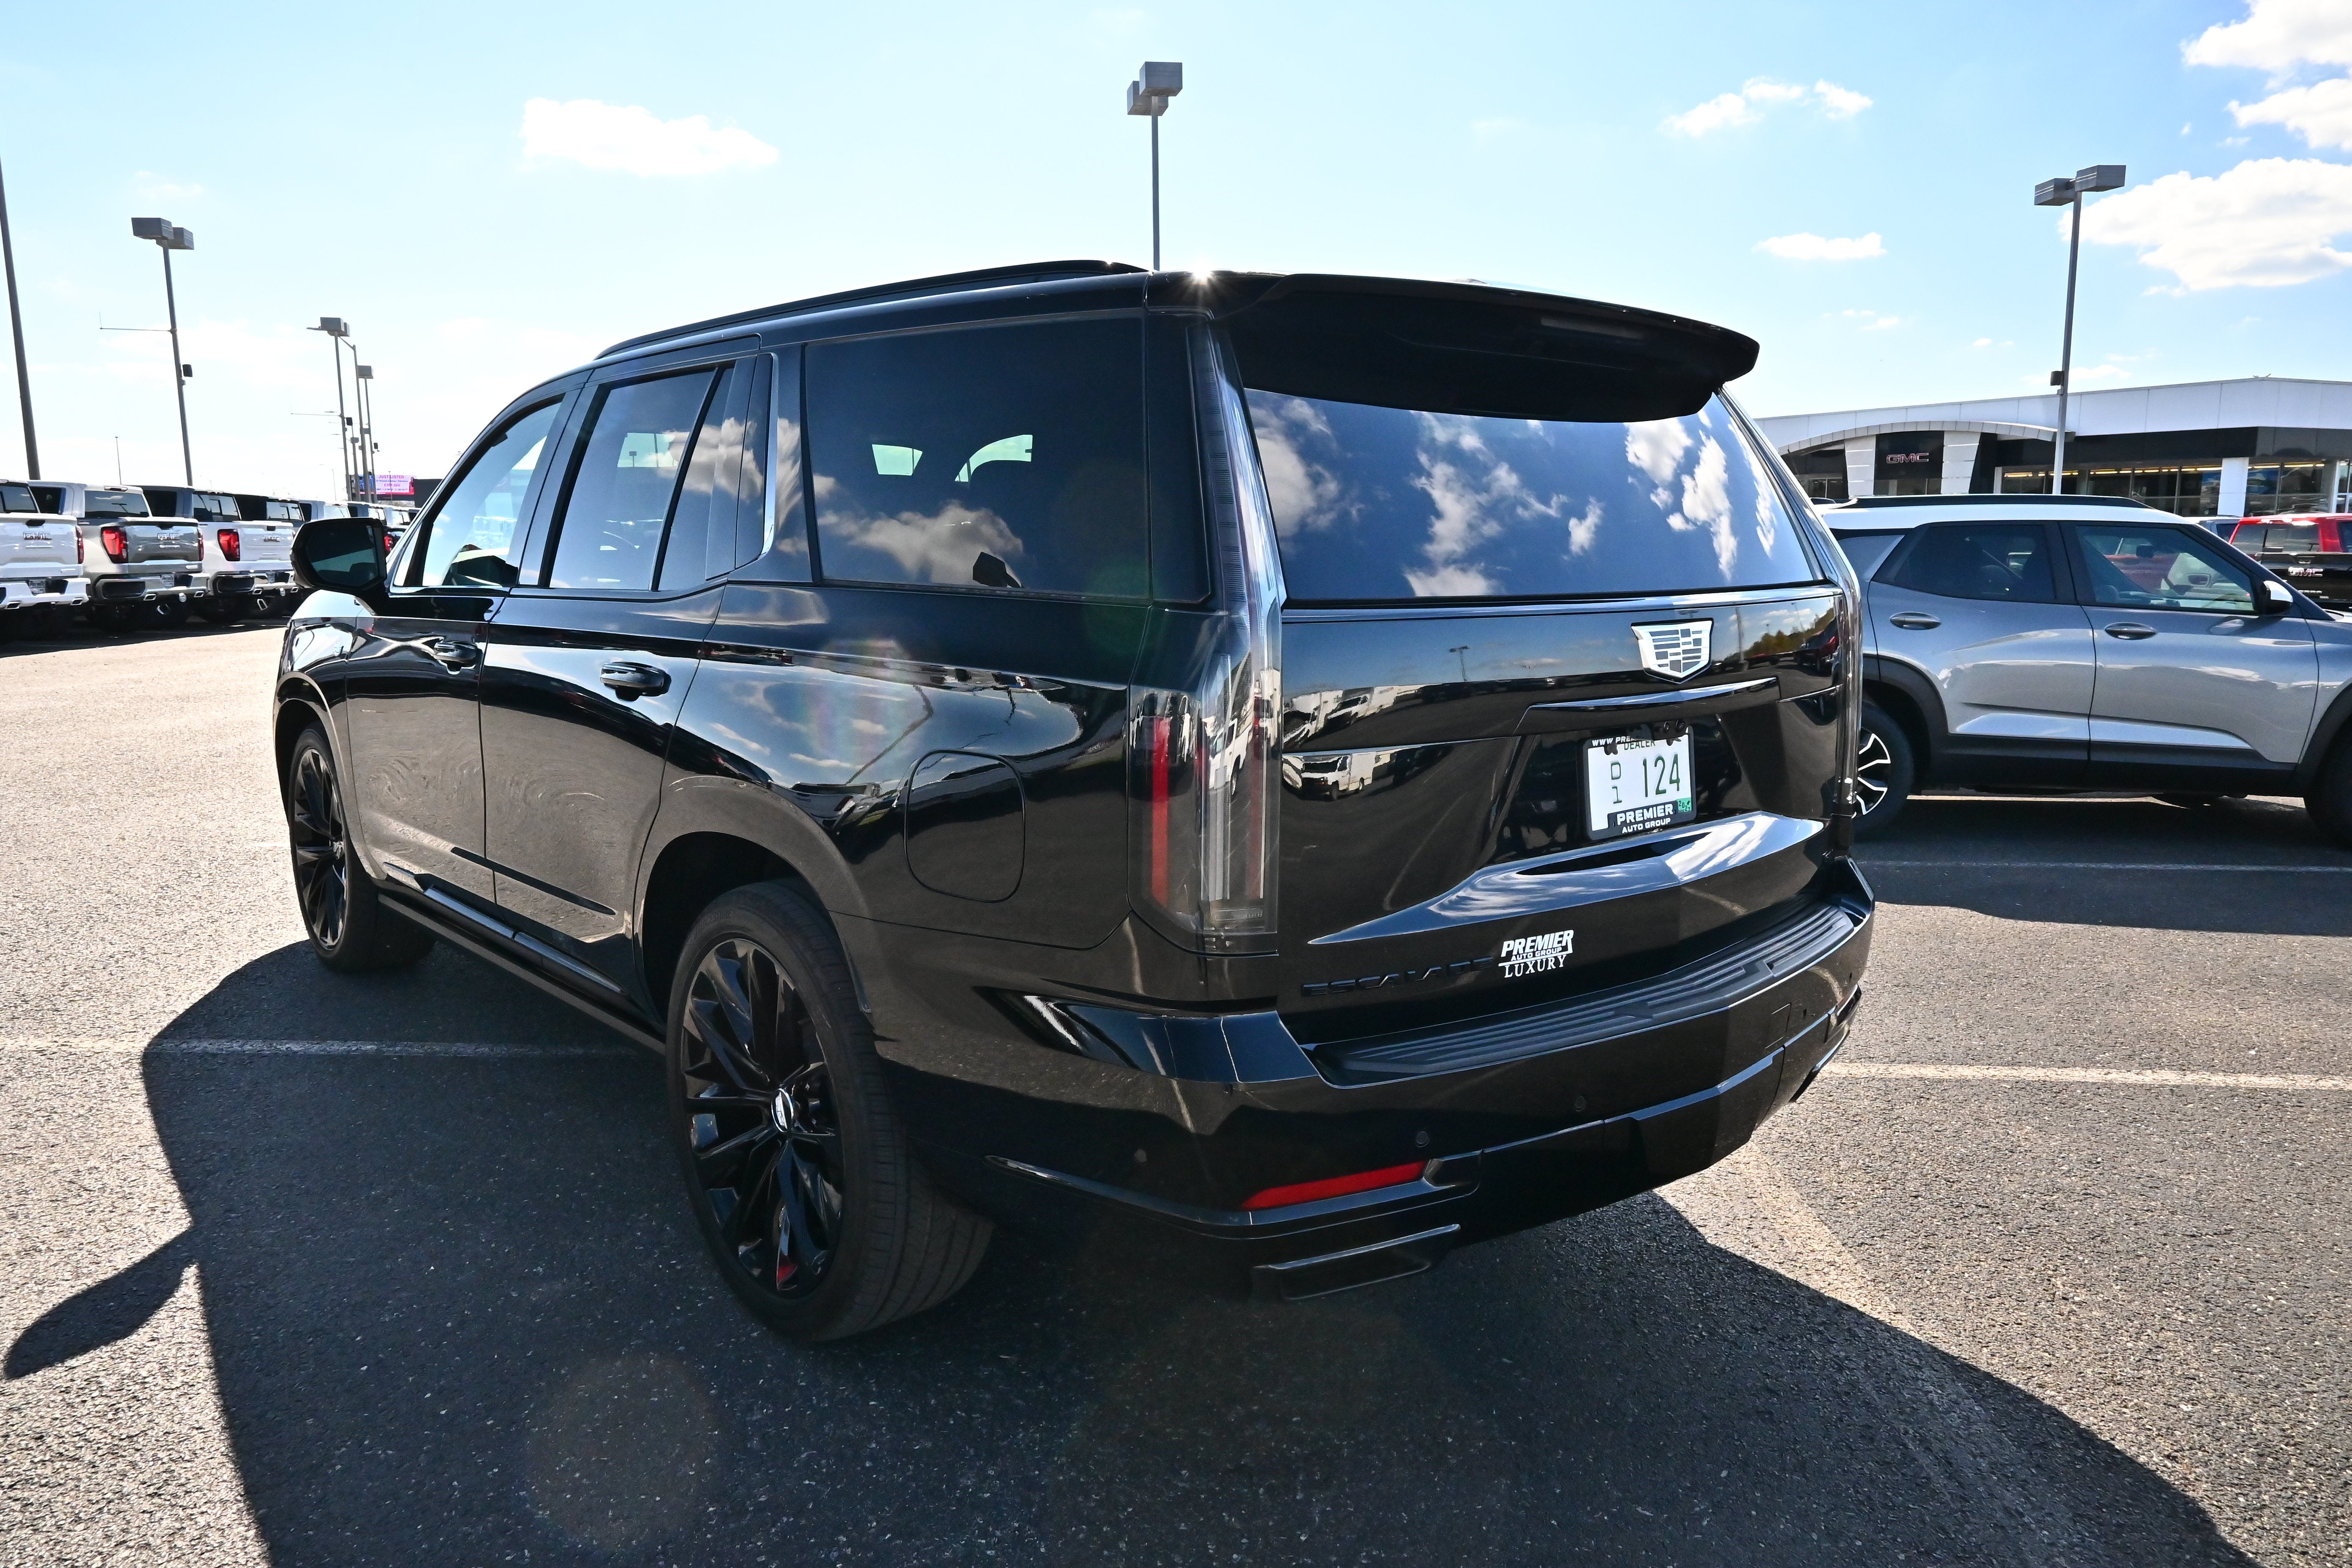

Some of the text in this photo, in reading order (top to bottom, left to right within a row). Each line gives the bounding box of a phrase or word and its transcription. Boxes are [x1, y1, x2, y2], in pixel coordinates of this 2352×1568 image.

[1886, 452, 1929, 463] GMC
[23, 531, 52, 540] GMC
[2288, 567, 2323, 577] GMC
[1624, 740, 1655, 751] DEALER
[1643, 754, 1680, 797] 124
[1617, 803, 1673, 825] PREMIER
[1622, 818, 1671, 833] AUTO GROUP
[1500, 930, 1574, 957] PREMIER
[1511, 947, 1562, 961] AUTO GROUP
[1504, 954, 1567, 978] LUXURY
[1302, 957, 1493, 996] ESCALADE
